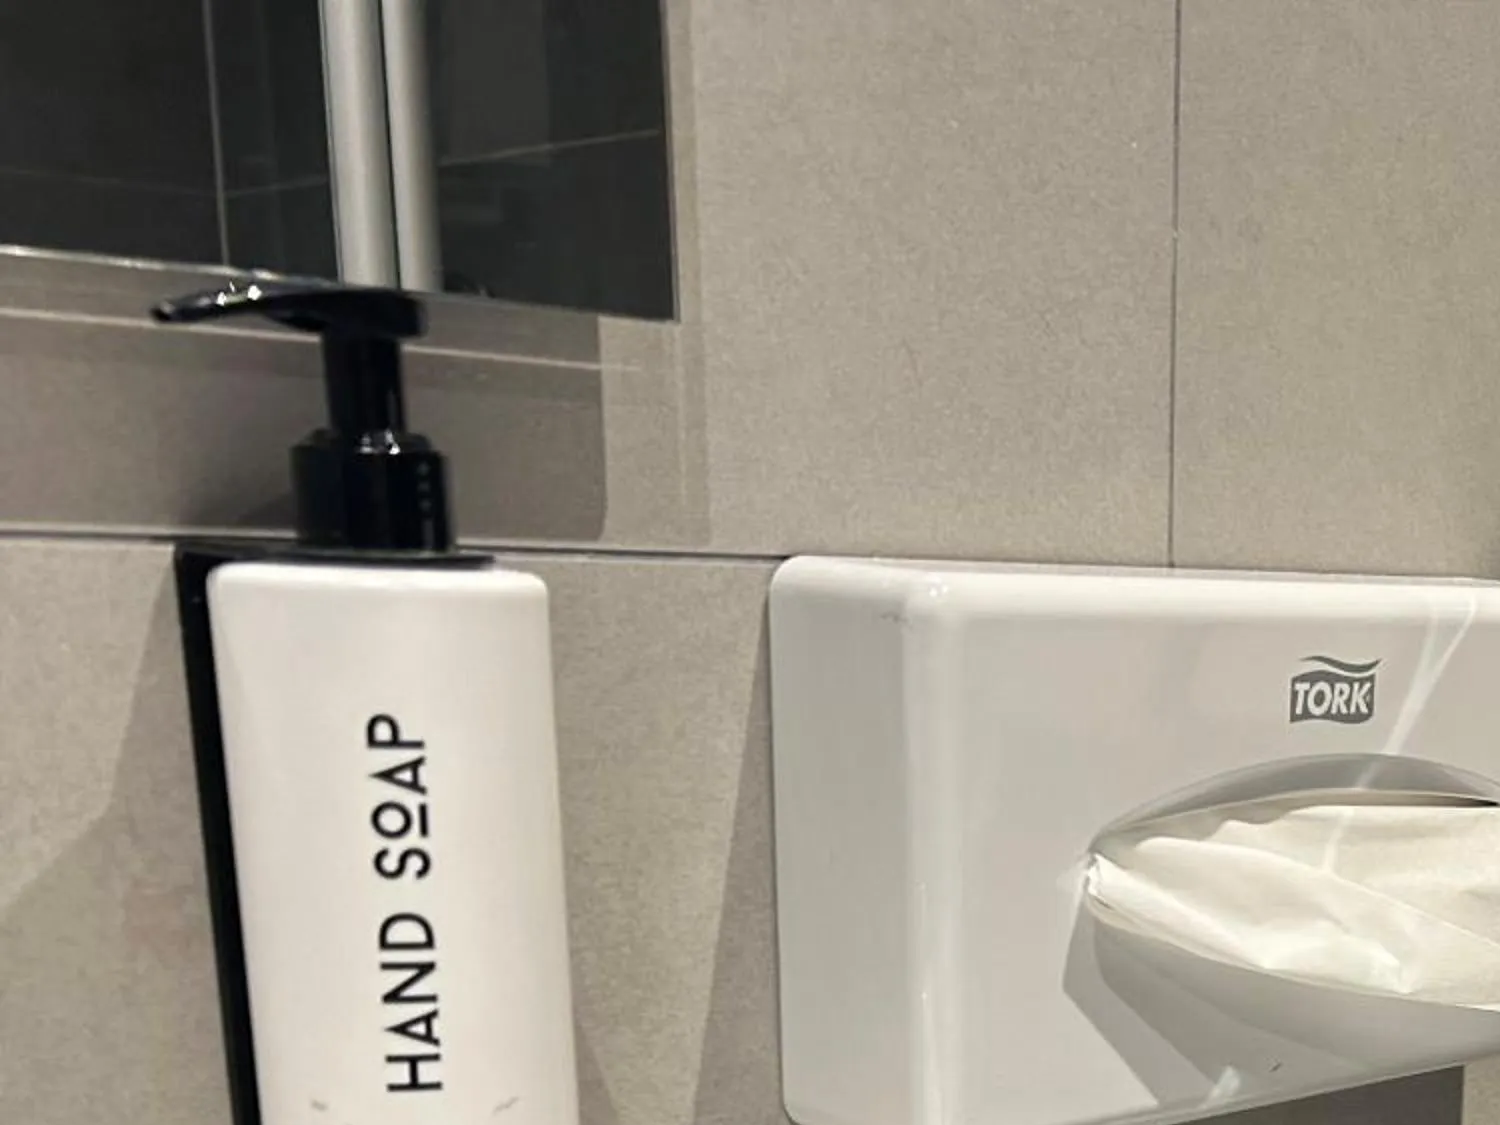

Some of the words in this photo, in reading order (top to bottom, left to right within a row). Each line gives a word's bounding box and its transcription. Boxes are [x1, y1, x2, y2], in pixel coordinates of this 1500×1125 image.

[1294, 681, 1372, 716] TORK
[366, 714, 431, 880] SOAP
[378, 912, 443, 1092] HAND
